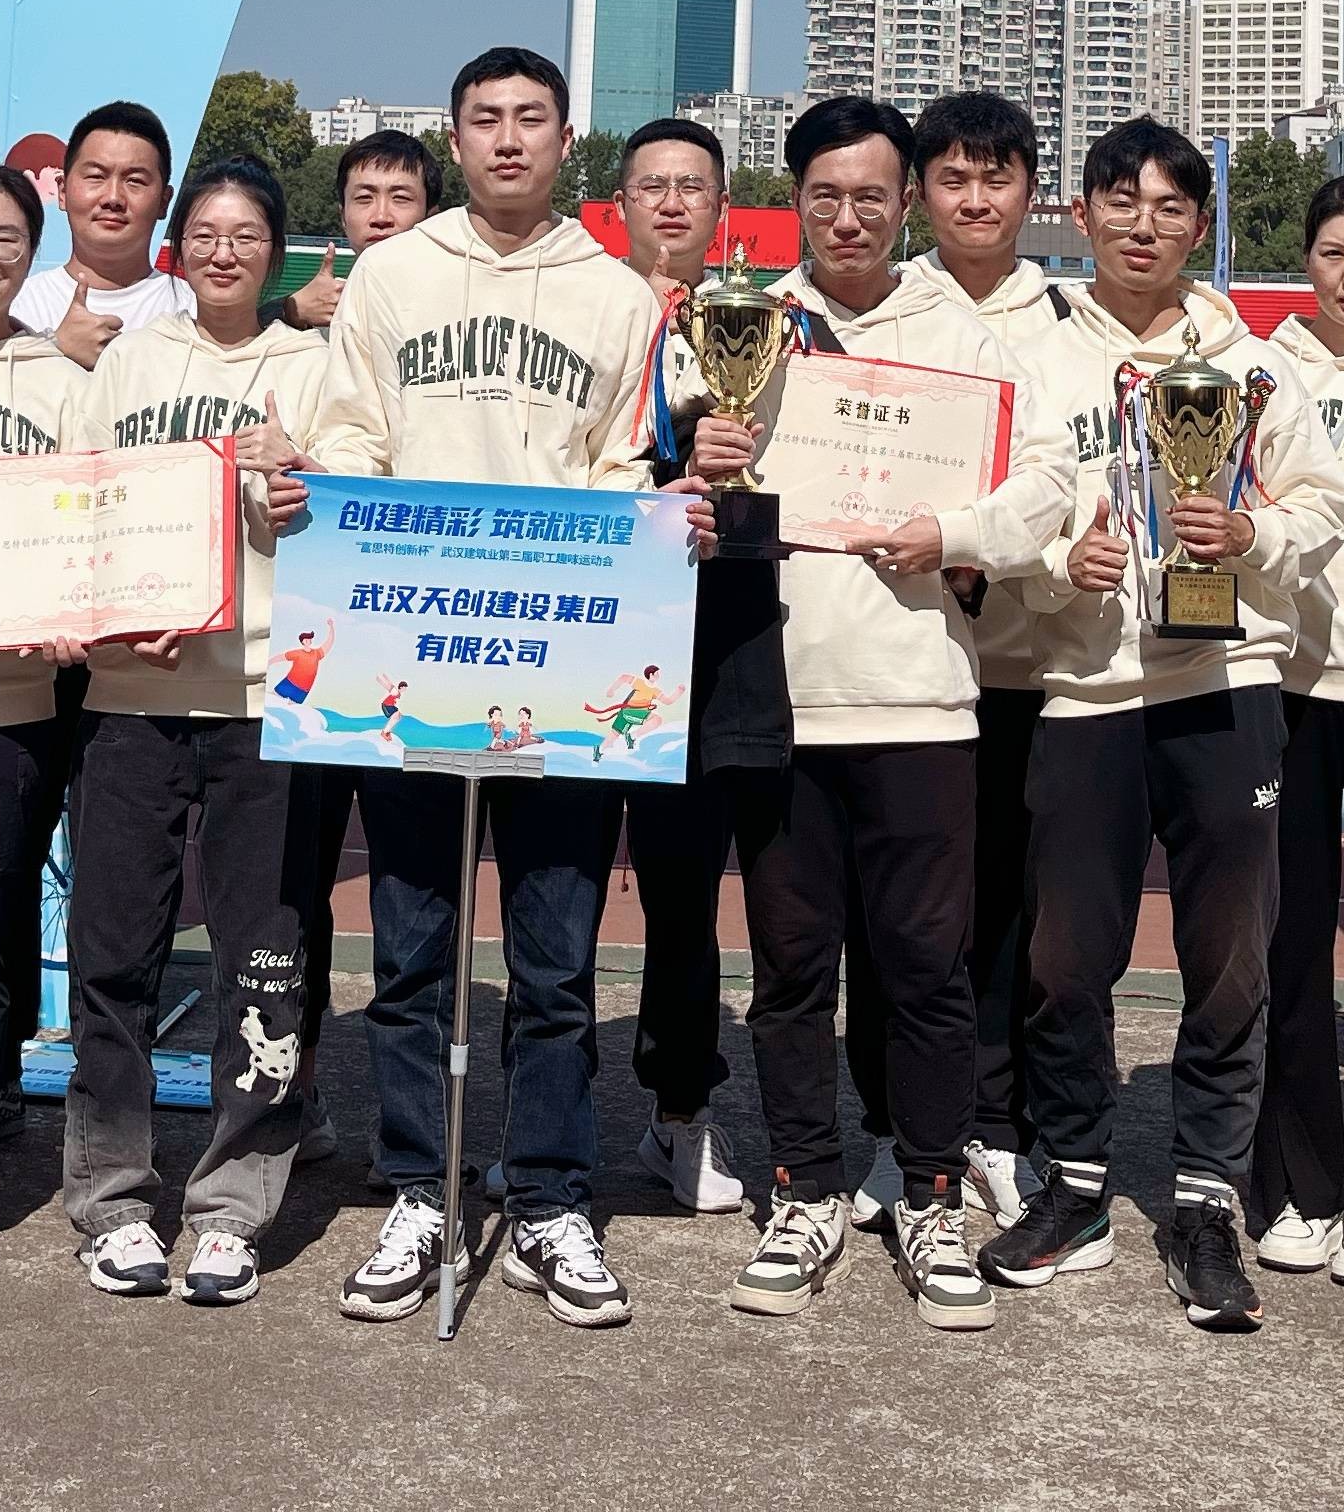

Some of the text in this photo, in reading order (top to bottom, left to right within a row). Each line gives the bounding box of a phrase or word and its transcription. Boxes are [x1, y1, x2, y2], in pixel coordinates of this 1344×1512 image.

[397, 317, 478, 388] DREAM
[482, 315, 516, 377] OF
[515, 322, 596, 410] YOUTH
[833, 397, 911, 425] 荣誉证书
[338, 500, 635, 545] 创建精彩 筑就辉煌
[348, 583, 620, 625] 武汉天创建设集团
[415, 634, 550, 668] 有限公司
[250, 949, 296, 969] Heal
